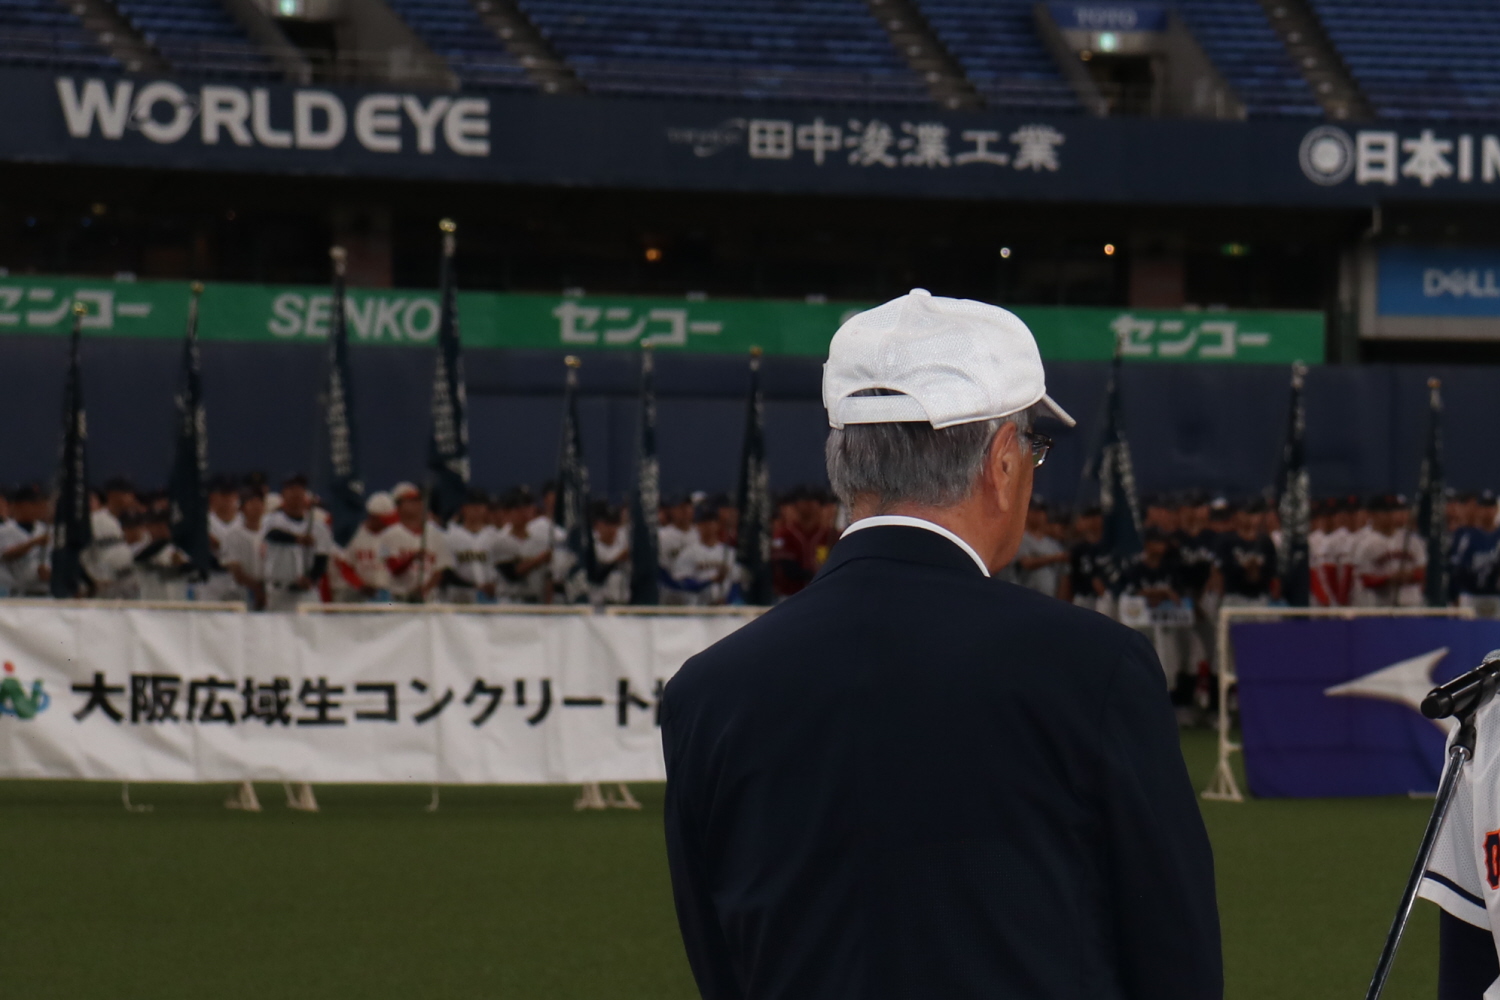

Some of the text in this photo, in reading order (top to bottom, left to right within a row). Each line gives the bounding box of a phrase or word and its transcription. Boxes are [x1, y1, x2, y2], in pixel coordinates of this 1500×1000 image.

[56, 76, 491, 157] WORLD EYE
[267, 292, 441, 342] SENKO
[551, 299, 723, 347] センコー
[1110, 313, 1271, 358] センコー
